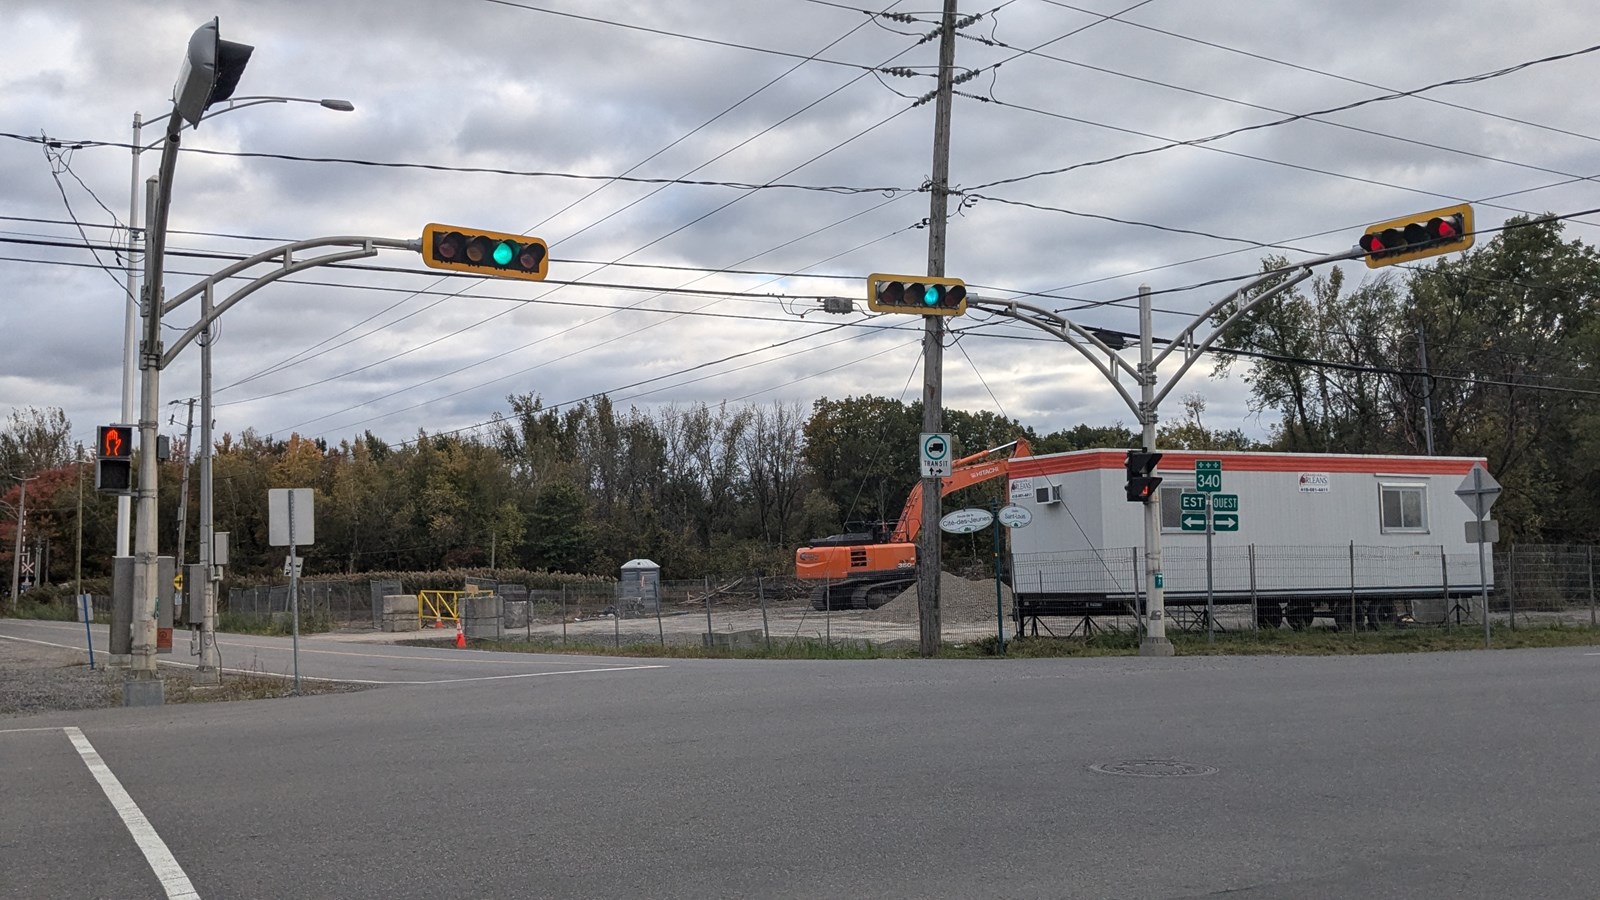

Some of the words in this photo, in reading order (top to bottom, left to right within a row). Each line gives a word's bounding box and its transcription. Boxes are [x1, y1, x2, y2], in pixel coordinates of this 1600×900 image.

[975, 466, 999, 477] HITACHI
[1197, 474, 1220, 488] 340
[1183, 497, 1204, 507] EST
[1213, 497, 1237, 508] OUEST
[942, 515, 990, 527] Cité-des-Jeunes
